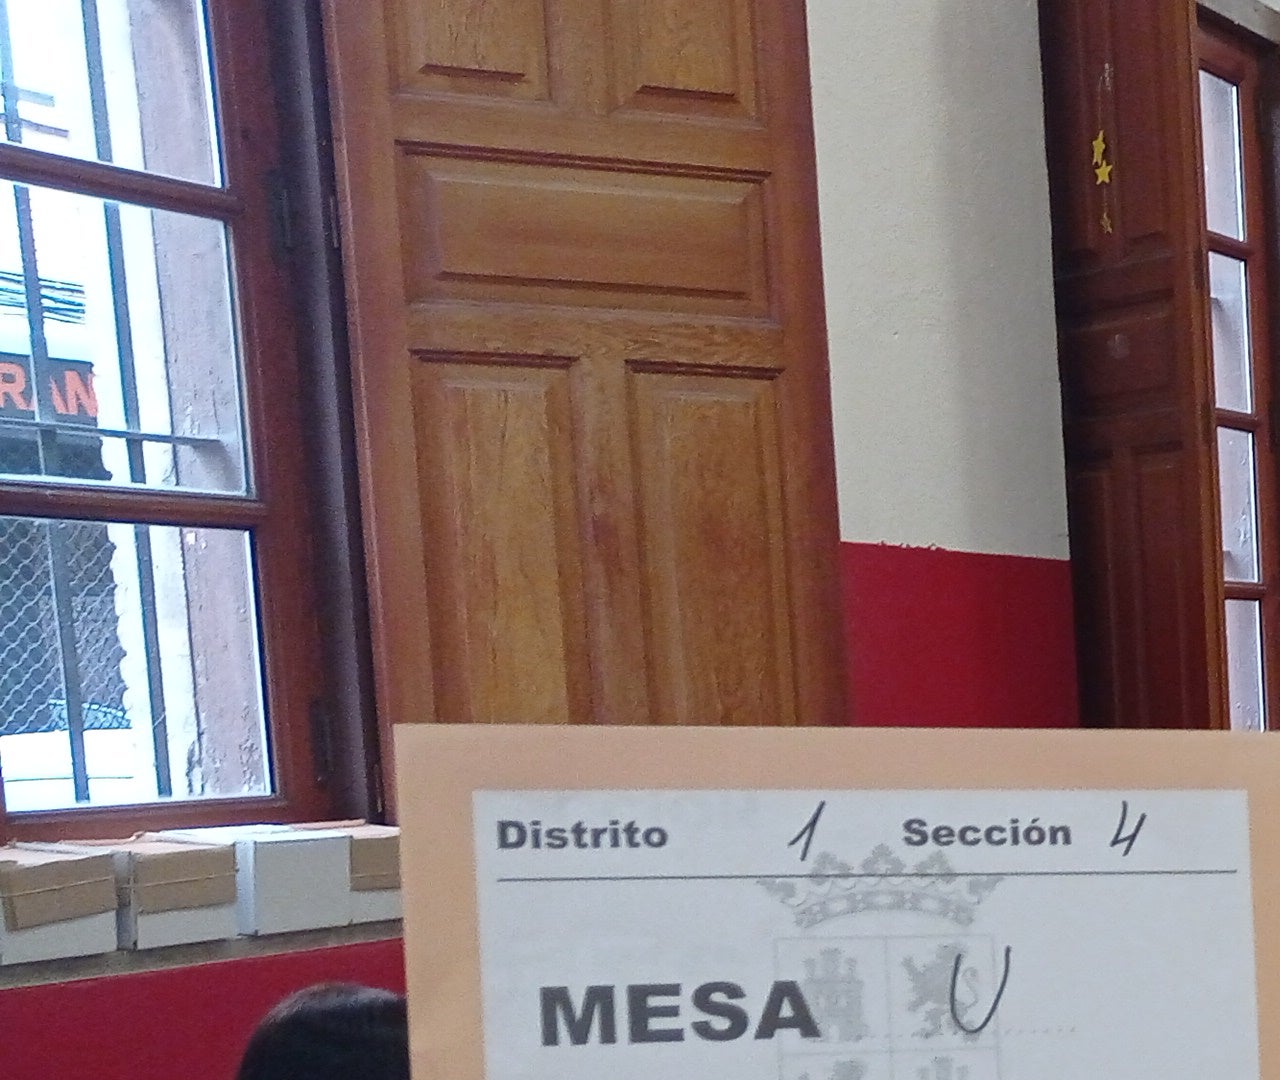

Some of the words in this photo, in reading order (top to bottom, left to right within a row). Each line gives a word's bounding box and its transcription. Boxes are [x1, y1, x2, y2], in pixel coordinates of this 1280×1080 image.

[497, 820, 669, 851] Distrito
[788, 801, 826, 862] 1
[903, 817, 1072, 848] Sección
[1110, 800, 1147, 857] 4
[540, 979, 823, 1047] MESA
[949, 945, 1012, 1036] U
